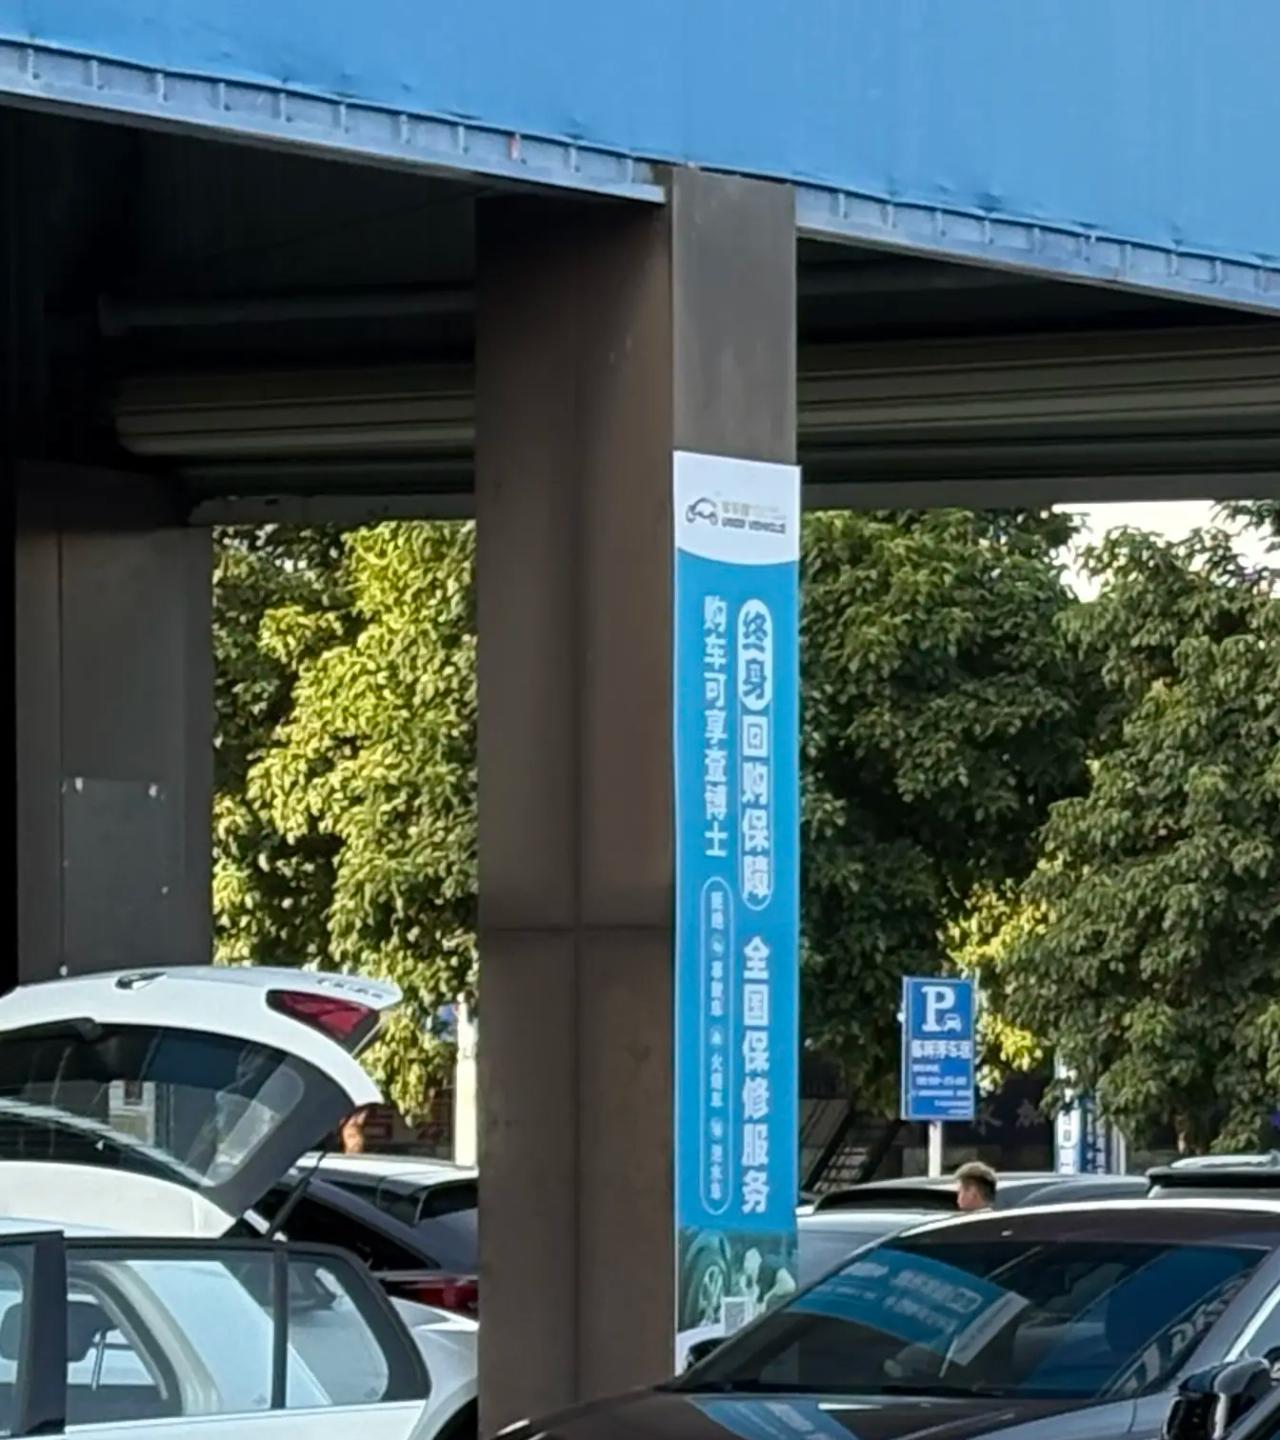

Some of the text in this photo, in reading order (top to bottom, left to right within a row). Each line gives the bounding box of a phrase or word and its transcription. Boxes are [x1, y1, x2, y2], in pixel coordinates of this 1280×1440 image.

[740, 936, 771, 1214] 全国保修服务
[921, 986, 955, 1032] P
